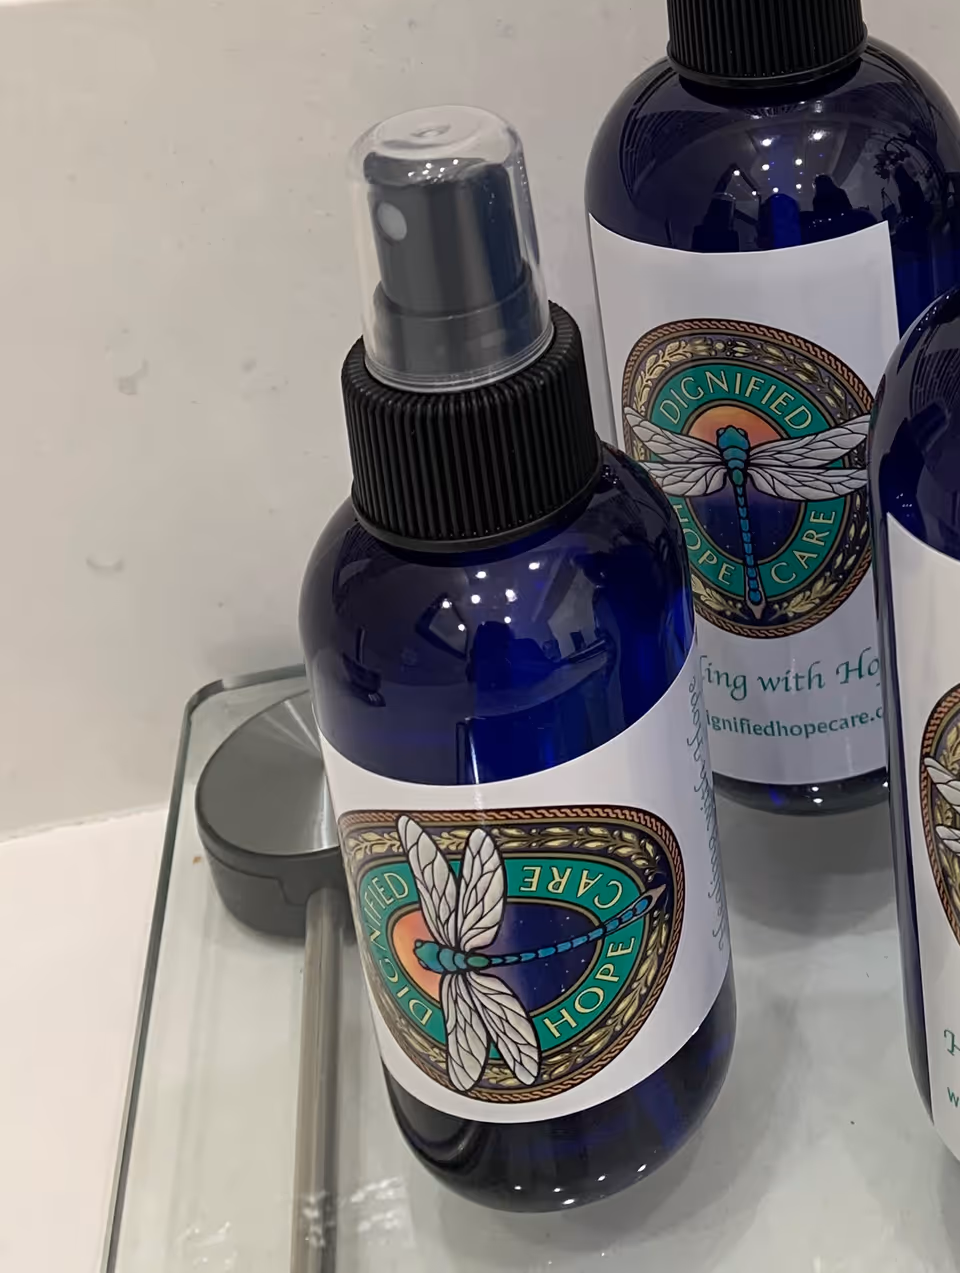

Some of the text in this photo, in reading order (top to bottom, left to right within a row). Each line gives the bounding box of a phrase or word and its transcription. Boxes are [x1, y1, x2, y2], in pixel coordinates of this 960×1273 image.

[660, 370, 812, 430] DIGNIFIED
[771, 510, 836, 584] CARE
[757, 660, 825, 693] with
[363, 871, 433, 1027] DIGNIFIED
[520, 865, 636, 1039] HOPE CARE
